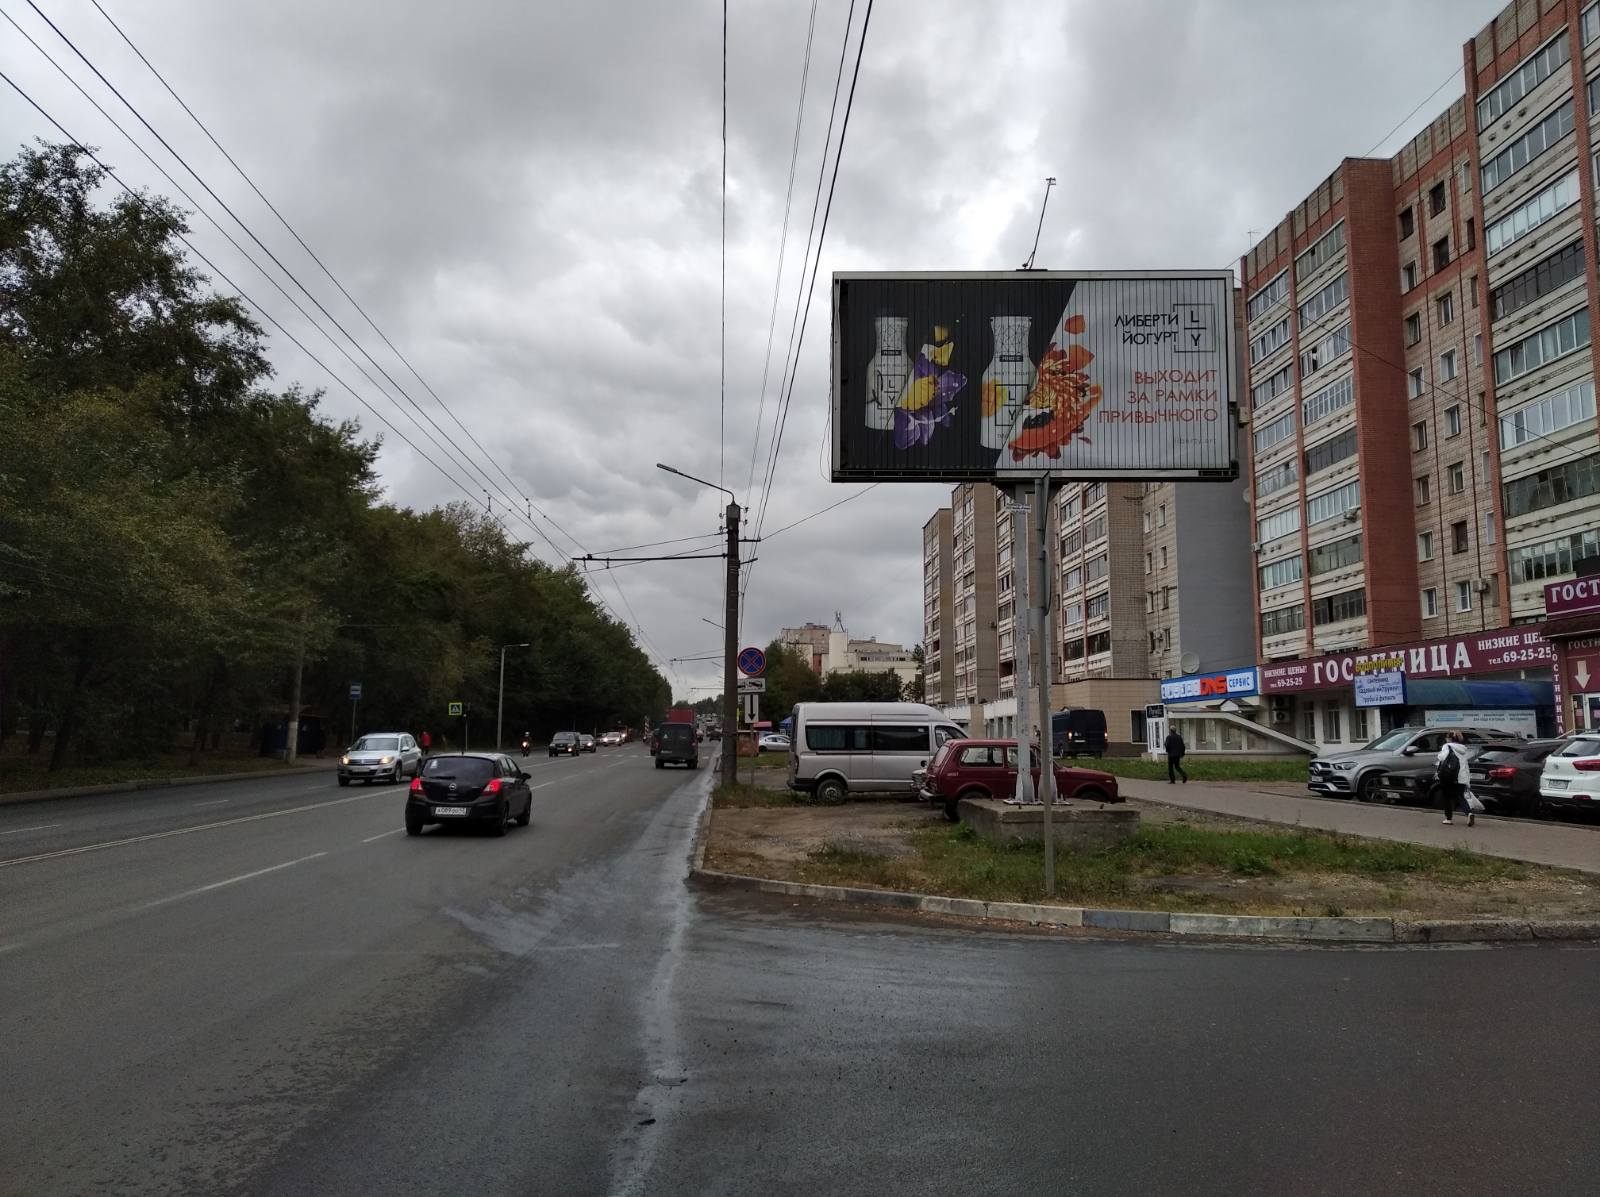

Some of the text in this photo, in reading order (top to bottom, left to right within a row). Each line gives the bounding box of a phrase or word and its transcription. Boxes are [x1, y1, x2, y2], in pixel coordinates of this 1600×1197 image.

[1115, 313, 1179, 327] ЛИБЕРТИ
[1190, 310, 1200, 323] L
[1122, 330, 1178, 345] ЙОГУРТ
[1191, 333, 1201, 346] Y
[1134, 369, 1217, 384] ВЫХОДИТ
[1127, 389, 1218, 404] ЗА РАМКИ
[1098, 408, 1218, 424] ПРИВЫЧНОГО
[1477, 635, 1520, 651] НИЗКИЕ
[1503, 646, 1552, 663] 69-25-25
[1229, 676, 1251, 689] СЕРВИС
[1277, 676, 1303, 688] 69-25-25
